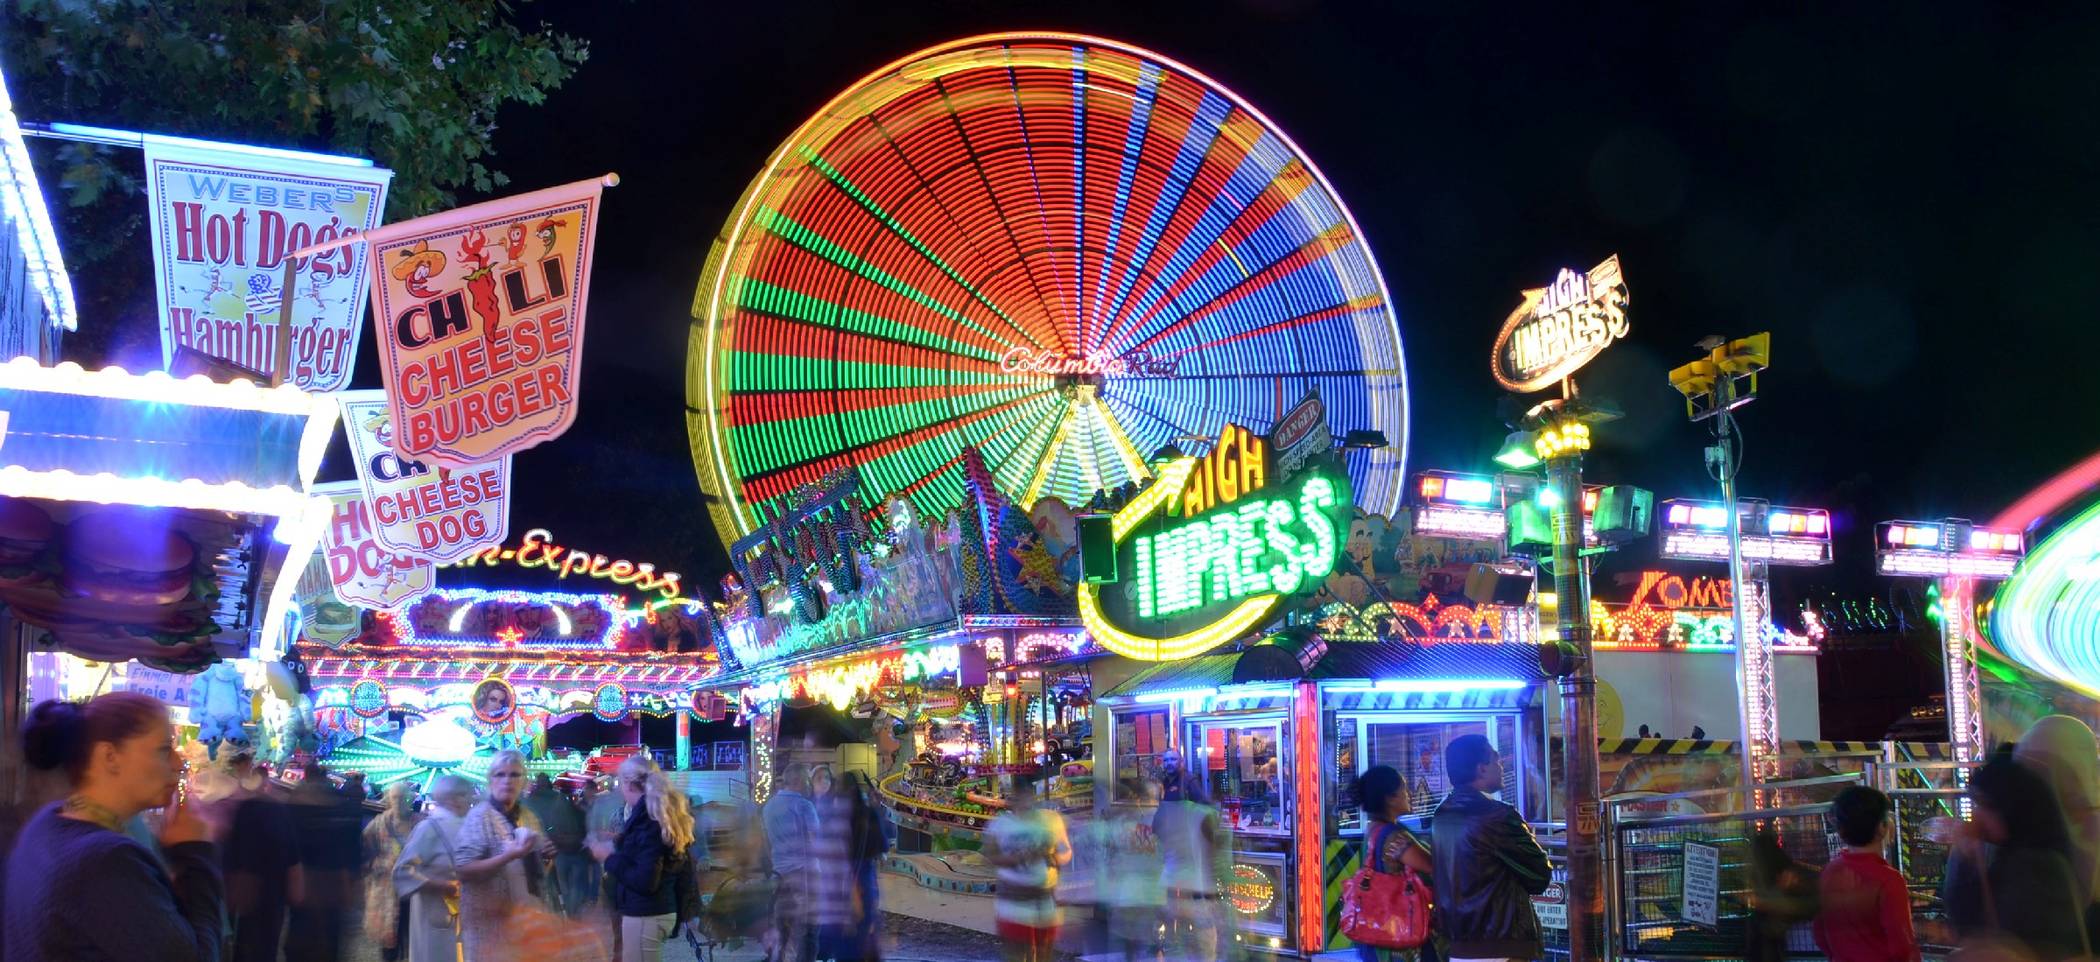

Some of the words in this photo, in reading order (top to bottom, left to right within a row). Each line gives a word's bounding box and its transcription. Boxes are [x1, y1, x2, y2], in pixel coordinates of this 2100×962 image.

[172, 201, 248, 267] Hot
[256, 209, 361, 281] Dogs
[1514, 286, 1630, 373] IMPRESS
[1533, 267, 1589, 316] HIGH
[170, 307, 350, 386] Hamburger
[400, 306, 572, 409] CHEESE
[1000, 346, 1123, 375] Columbia
[409, 363, 572, 452] BURGER
[373, 469, 503, 526] CHEESE
[1184, 423, 1265, 518] HIGH
[415, 508, 487, 551] DOG
[1135, 475, 1336, 618] IMPRESS
[1542, 887, 1562, 899] GER
